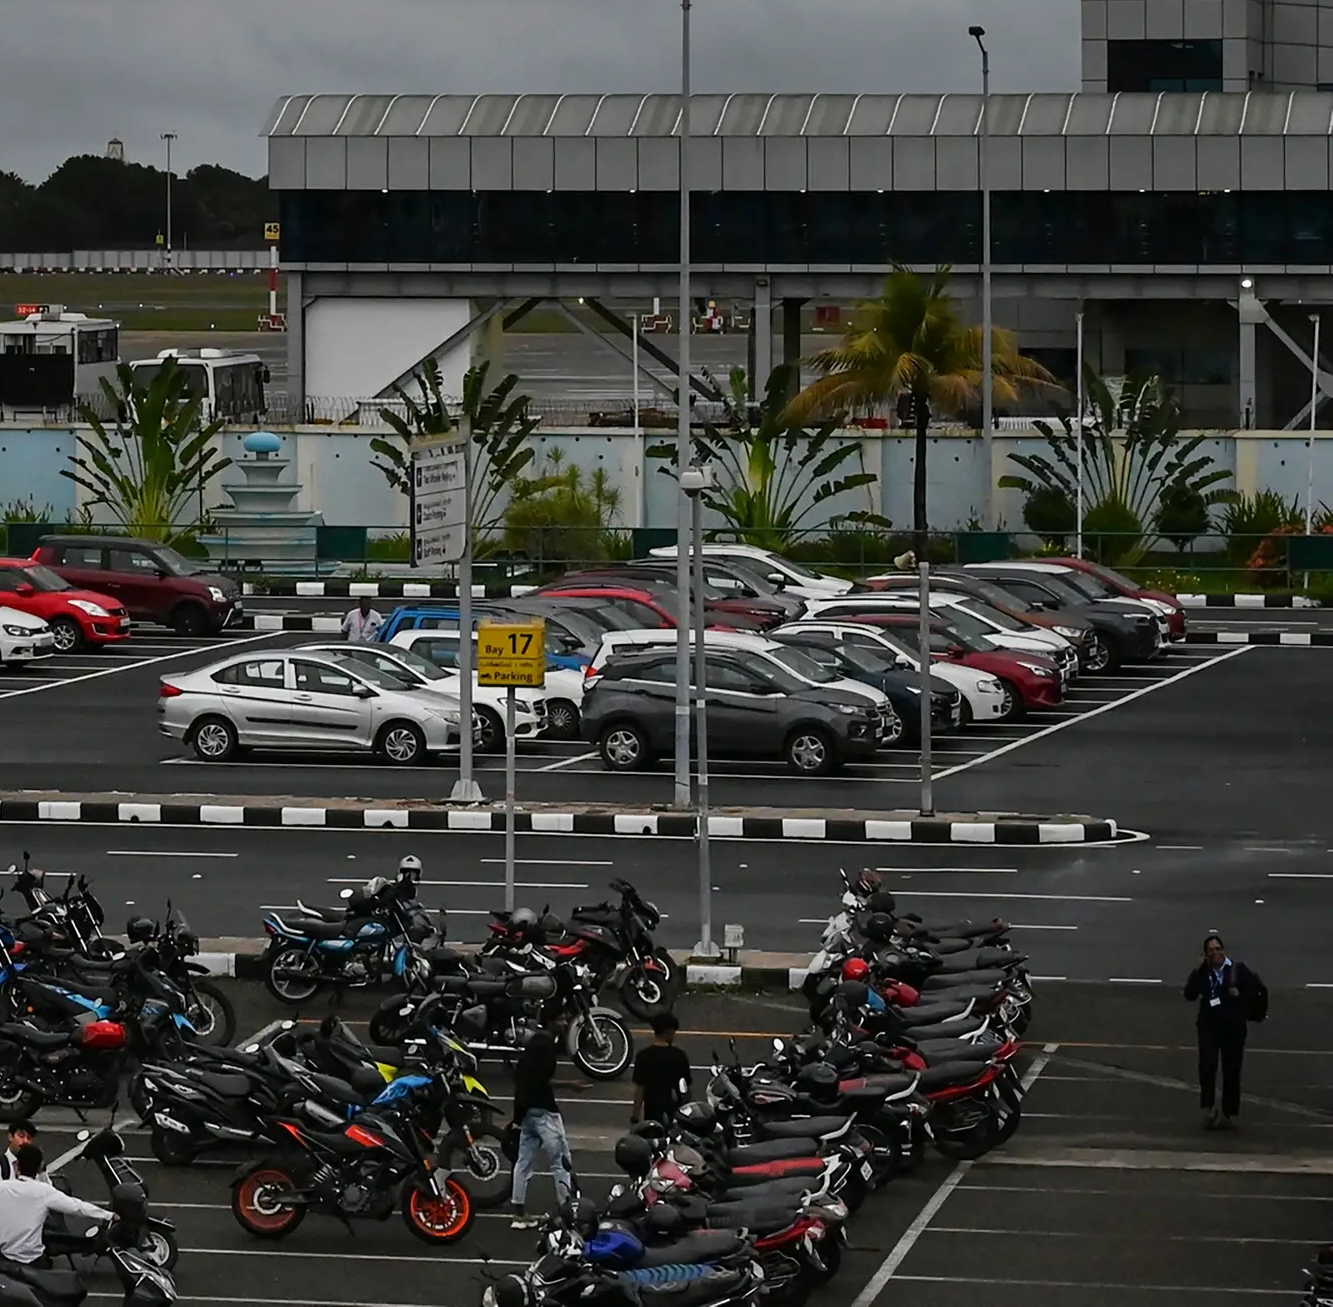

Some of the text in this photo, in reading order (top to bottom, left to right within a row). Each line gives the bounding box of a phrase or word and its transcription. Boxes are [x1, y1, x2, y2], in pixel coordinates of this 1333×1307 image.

[266, 224, 279, 234] 45
[485, 633, 534, 656] Bay 17
[494, 671, 533, 683] Parking
